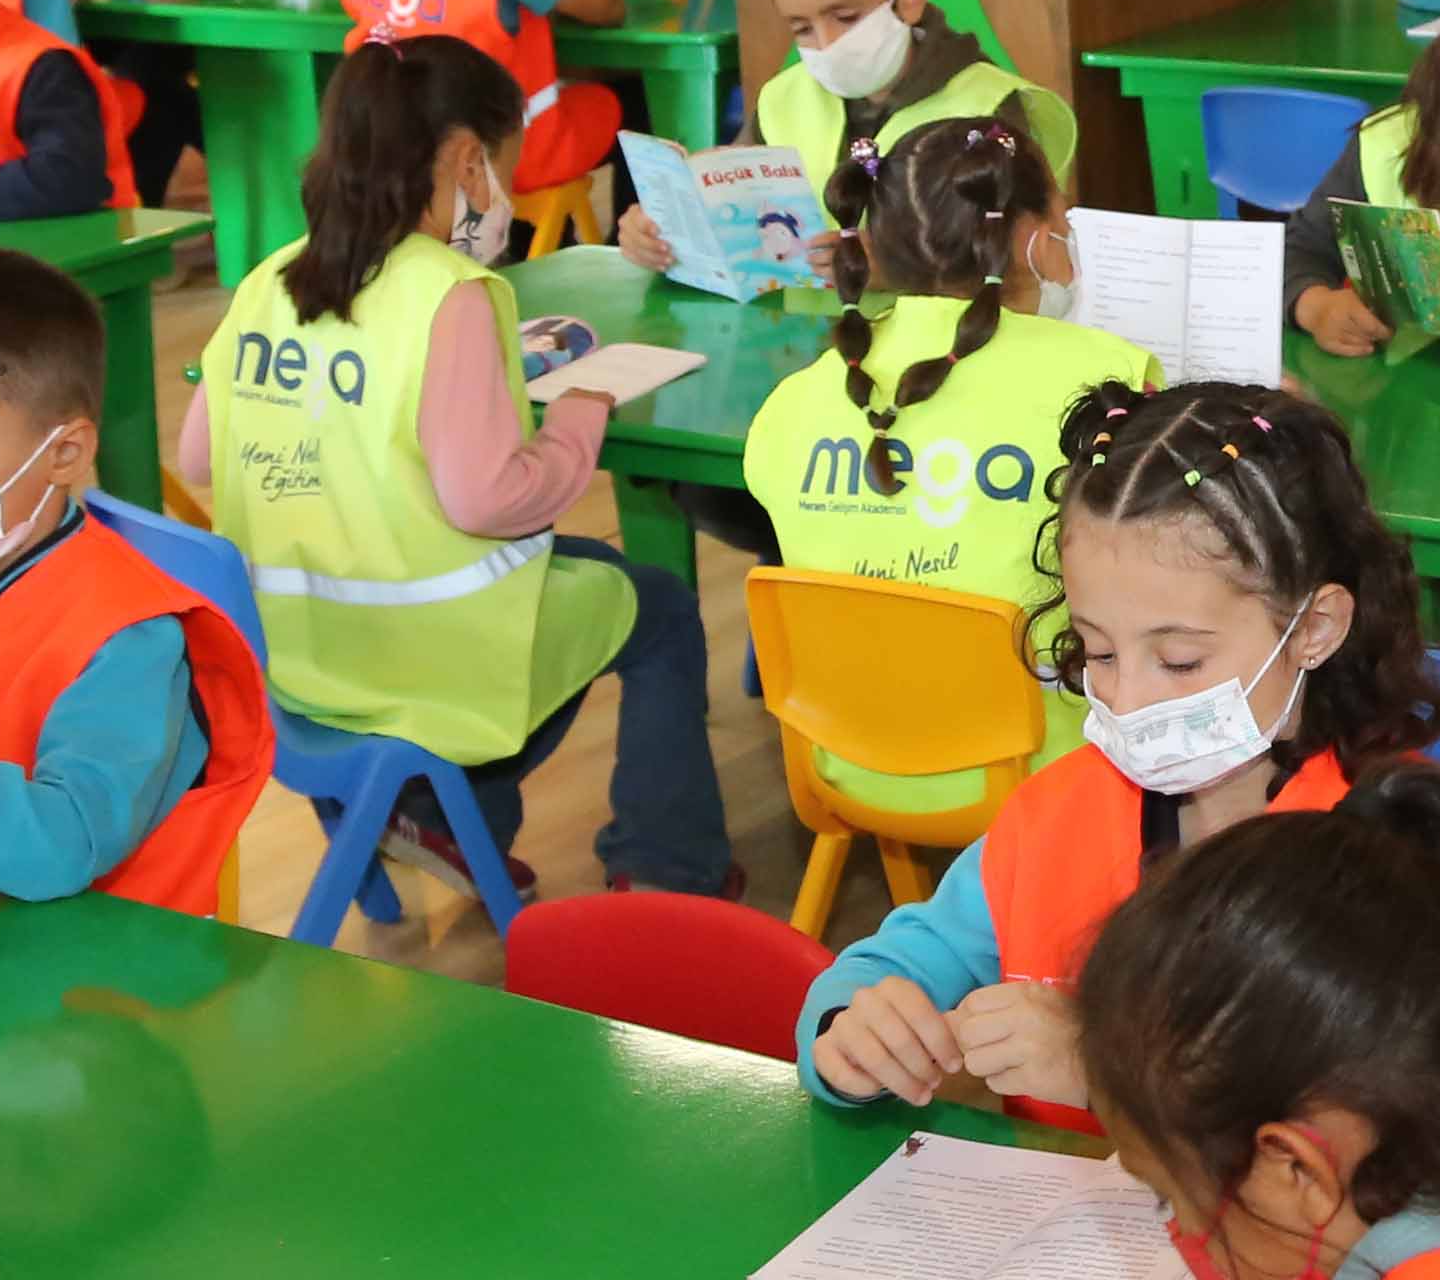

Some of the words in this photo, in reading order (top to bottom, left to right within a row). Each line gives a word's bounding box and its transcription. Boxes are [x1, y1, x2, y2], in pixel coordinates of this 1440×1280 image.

[702, 167, 753, 188] Küçük
[799, 435, 1035, 528] mega
[904, 541, 960, 579] Nesil
